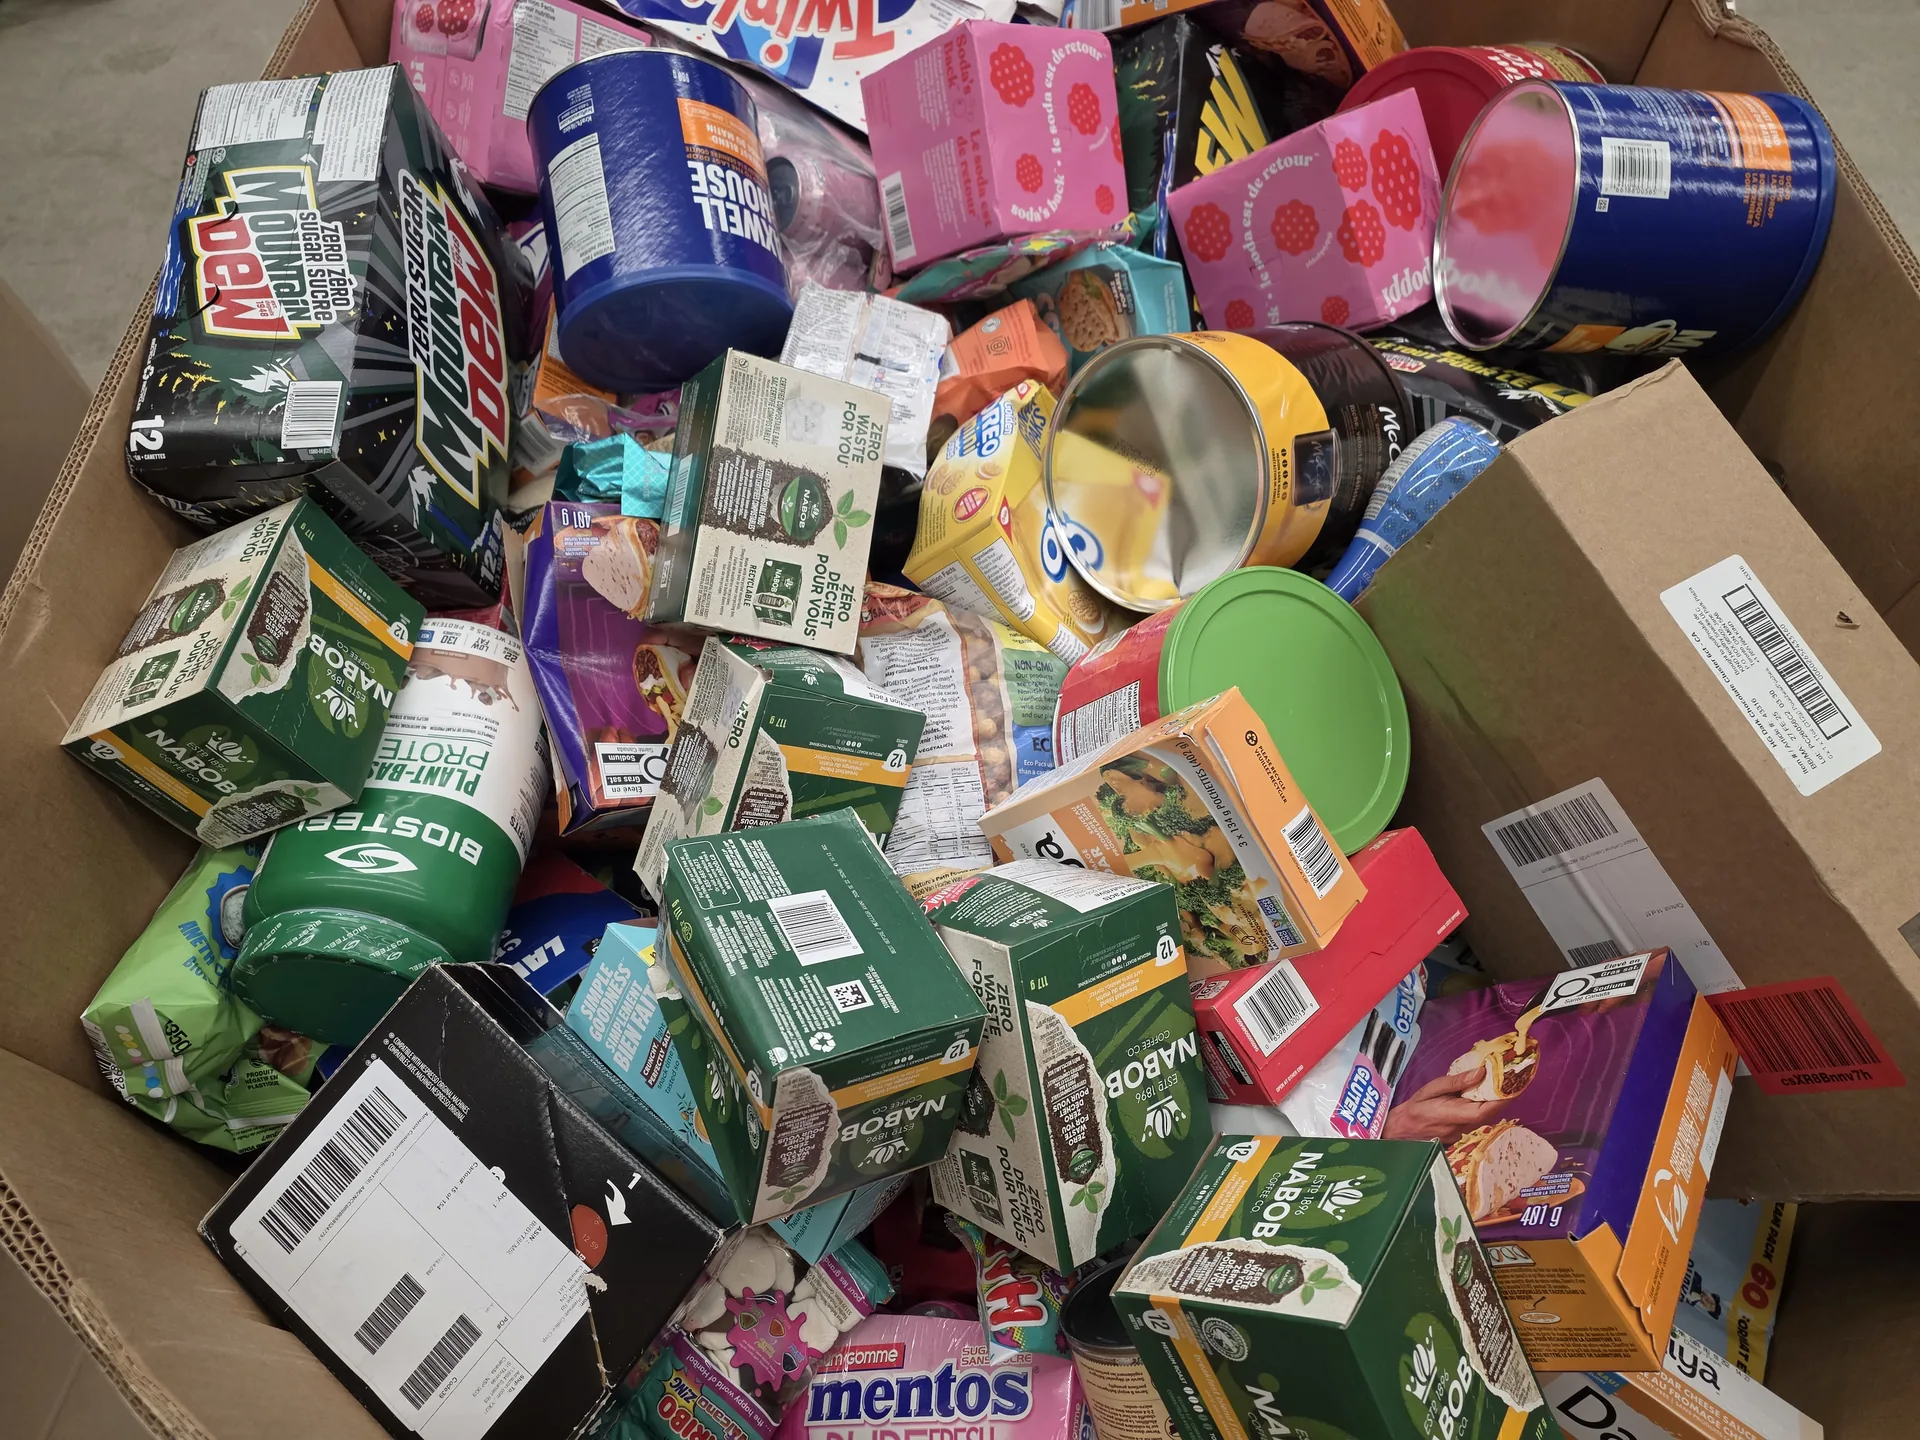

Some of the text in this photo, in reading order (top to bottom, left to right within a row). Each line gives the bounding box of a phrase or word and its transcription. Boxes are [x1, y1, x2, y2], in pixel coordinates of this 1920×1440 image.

[1048, 47, 1066, 64] de
[1041, 62, 1058, 89] est
[1044, 92, 1057, 134] soda
[1051, 137, 1061, 154] le
[1046, 173, 1066, 211] back
[1245, 176, 1264, 198] de
[1781, 174, 1794, 200] GOOD
[1237, 198, 1257, 228] est
[841, 400, 856, 431] FOR
[129, 414, 164, 451] 12
[855, 414, 871, 464] WASTE
[869, 423, 884, 462] ZERO
[559, 507, 591, 529] 401 g
[797, 488, 810, 529] NABOB
[254, 520, 281, 557] WASTE
[812, 553, 830, 593] POUR
[941, 565, 956, 577] Facts
[743, 564, 757, 606] RECYCLABLE
[825, 571, 842, 630] DÉCHET
[836, 584, 853, 623] ZÉRO
[389, 621, 411, 643] 12
[440, 634, 458, 645] 130
[475, 636, 490, 645] FAT
[1689, 630, 1701, 643] CA
[470, 642, 489, 652] LOW
[183, 633, 216, 687] DÉCHET
[307, 631, 393, 708] NABOB
[348, 649, 376, 675] COFFEE
[1013, 657, 1054, 674] NON-GMO
[1709, 656, 1731, 684] Cluster
[1015, 671, 1052, 681] Our products
[1727, 682, 1756, 718] Chocolate
[1749, 696, 1768, 719] 43316
[1768, 688, 1785, 709] 03:30
[1752, 716, 1768, 735] Dark
[1771, 709, 1782, 721] 25
[1778, 719, 1790, 732] FE
[1764, 733, 1778, 749] HG
[1771, 726, 1791, 750] Article
[1786, 730, 1796, 741] 27
[94, 741, 115, 761] 12
[144, 722, 238, 800] NABOB
[607, 753, 635, 763] Sodium
[616, 745, 653, 754] Santé Canada
[889, 752, 903, 768] 12
[1813, 750, 1826, 765] Lot:
[819, 765, 858, 777] breakfast blend
[1253, 747, 1287, 804] VEUILLEZ RECYCLER
[1257, 744, 1286, 791] PLEASE RECYCLE
[1794, 757, 1809, 775] Item
[606, 775, 640, 784] Gras sat.
[622, 784, 642, 796] Élevé
[1076, 804, 1111, 851] FROMAGE SANS
[1157, 938, 1175, 959] 12
[1599, 963, 1641, 979] Gras sat.
[1603, 957, 1641, 972] Élevé en
[579, 961, 614, 1020] SIMPLE
[1113, 984, 1140, 1001] breakfast
[1563, 990, 1611, 1005] Santé Canada
[1592, 981, 1628, 994] Sodium
[587, 961, 632, 1042] GOODNESS
[977, 973, 1006, 1038] WASTE
[993, 980, 1016, 1033] ZERO
[604, 979, 644, 1053] SIMPLEMENT
[611, 983, 661, 1072] BIEN FAIT
[642, 1041, 659, 1076] CRUNCHY.
[1102, 1031, 1197, 1099] NABOB
[245, 1069, 274, 1077] PRODUIT
[1780, 1067, 1873, 1086] csXR8Bnnv7h
[888, 1093, 923, 1109] COFFEE
[1342, 1063, 1373, 1123] GLUTEN
[836, 1094, 950, 1142] NABOB
[1355, 1084, 1379, 1130] SANS
[449, 1184, 459, 1193] 15
[1251, 1152, 1323, 1239] NABOB
[435, 1198, 447, 1211] 154
[1012, 1165, 1038, 1239] DÉCHET
[1027, 1182, 1049, 1234] ZÉRO
[1519, 1204, 1563, 1228] 401 g
[527, 1224, 543, 1242] ASIN
[838, 1276, 862, 1303] pour les
[1742, 1262, 1777, 1310] 60
[495, 1315, 509, 1330] PO#
[1147, 1311, 1168, 1335] 12
[808, 1361, 1030, 1422] mentos
[1667, 1384, 1722, 1430] FROMAGE
[1684, 1386, 1757, 1440] CHEESE SAUCE
